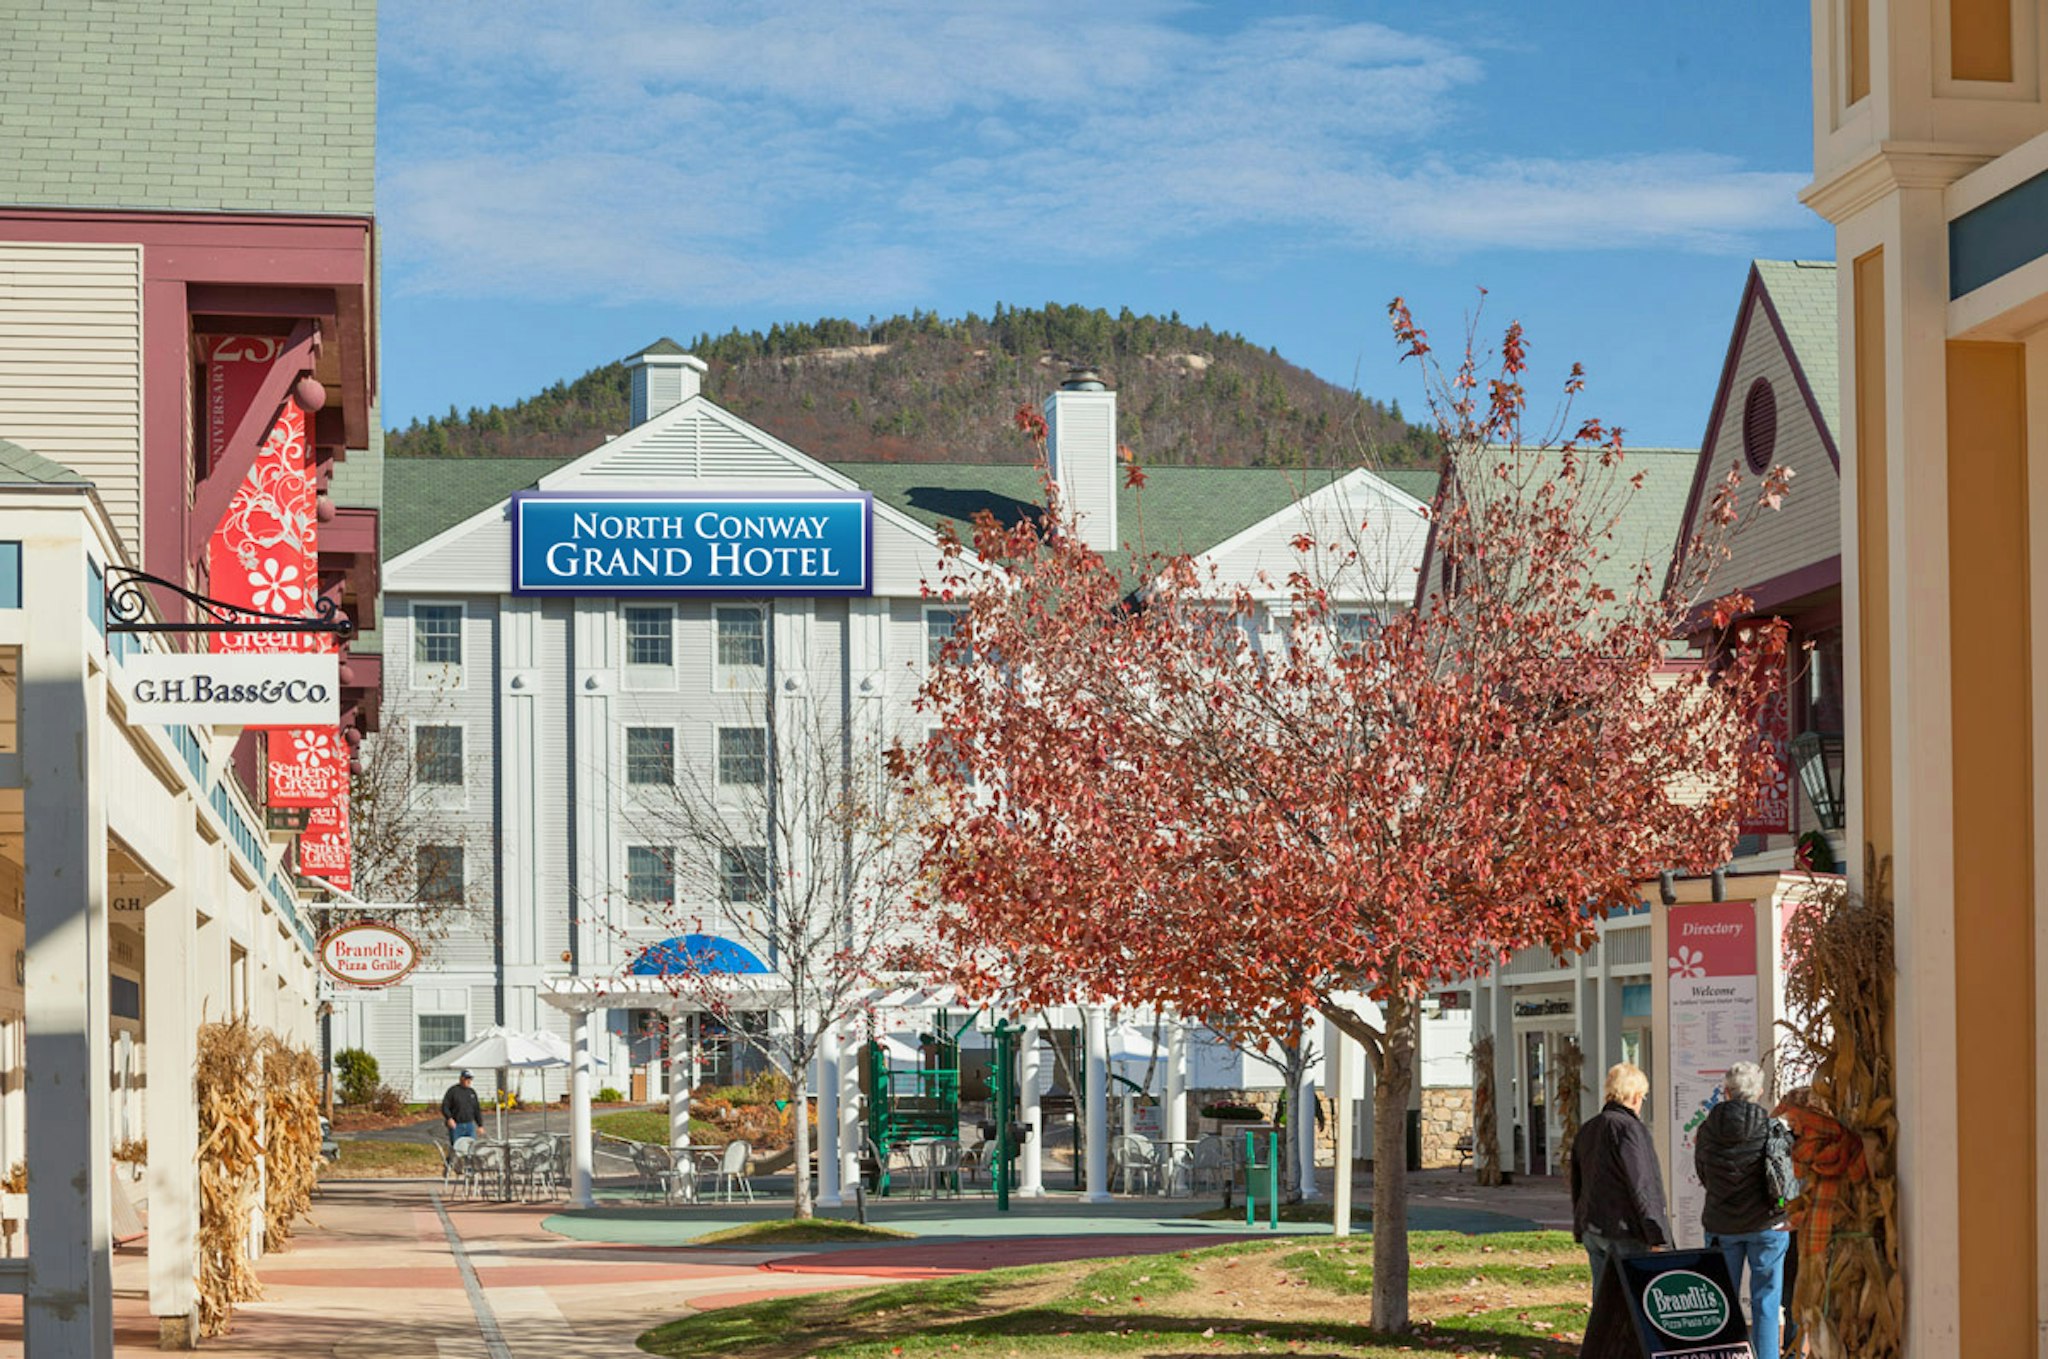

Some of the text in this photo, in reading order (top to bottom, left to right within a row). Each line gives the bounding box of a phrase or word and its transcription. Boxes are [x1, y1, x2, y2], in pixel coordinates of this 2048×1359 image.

[572, 512, 829, 539] NORTH CONWAY
[546, 542, 839, 577] GRAND HOTEL
[274, 775, 328, 790] Green
[1682, 922, 1743, 937] Directory
[335, 941, 404, 957] Brandli's
[338, 960, 402, 970] Pizza Grille
[1692, 986, 1736, 996] Welcome
[1651, 1283, 1718, 1313] Brandli's
